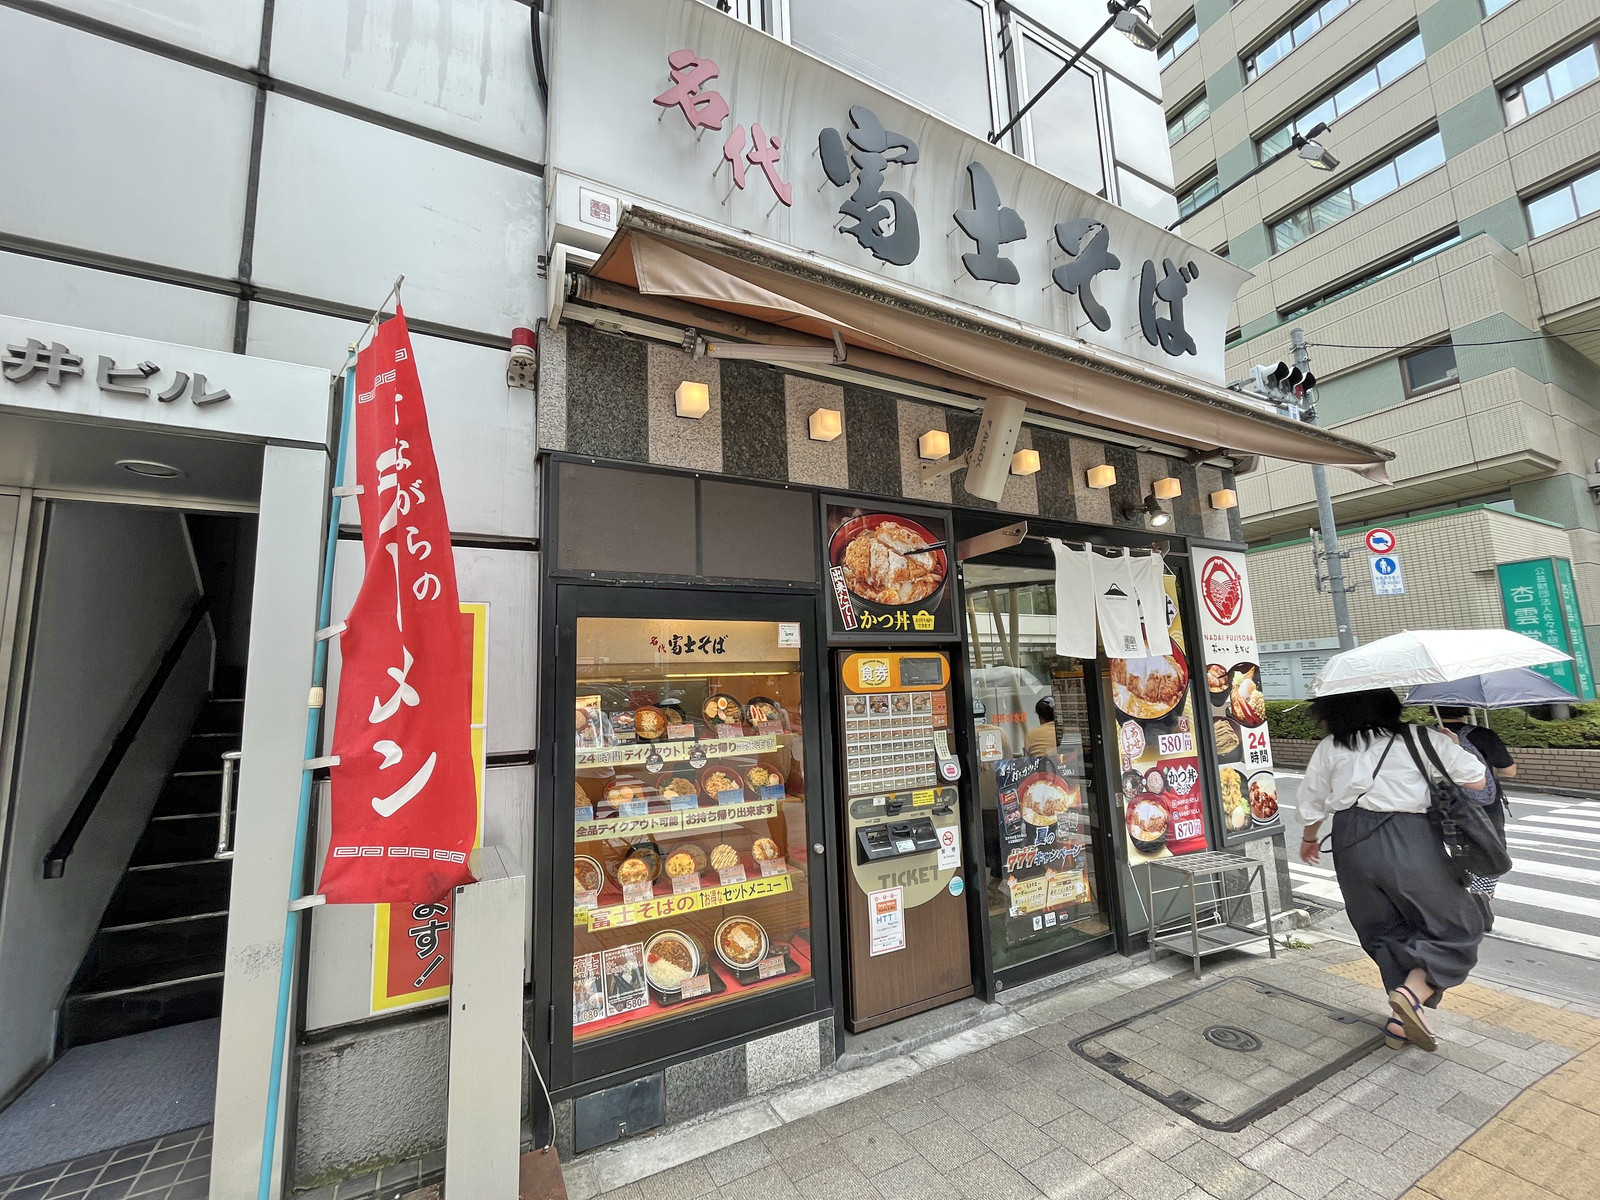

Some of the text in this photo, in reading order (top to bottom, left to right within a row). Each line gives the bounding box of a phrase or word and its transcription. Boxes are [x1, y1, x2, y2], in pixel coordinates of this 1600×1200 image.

[653, 48, 1199, 357] 名代 富士そば
[2, 338, 232, 408] 井ビル
[394, 393, 442, 602] ながらの
[860, 610, 911, 631] かつ丼
[650, 634, 729, 656] 名代 富士そば
[1226, 634, 1253, 642] FUJISOBA
[861, 665, 888, 682] 食券
[1248, 731, 1266, 750] 24
[1250, 749, 1269, 764] 時間
[1168, 768, 1196, 785] かつ丼
[576, 803, 775, 838] 全品テイクアウト可能 お持ち帰り出来ます
[877, 865, 939, 889] TICKET
[590, 896, 695, 930] 富士そばの
[876, 913, 893, 925] HTT
